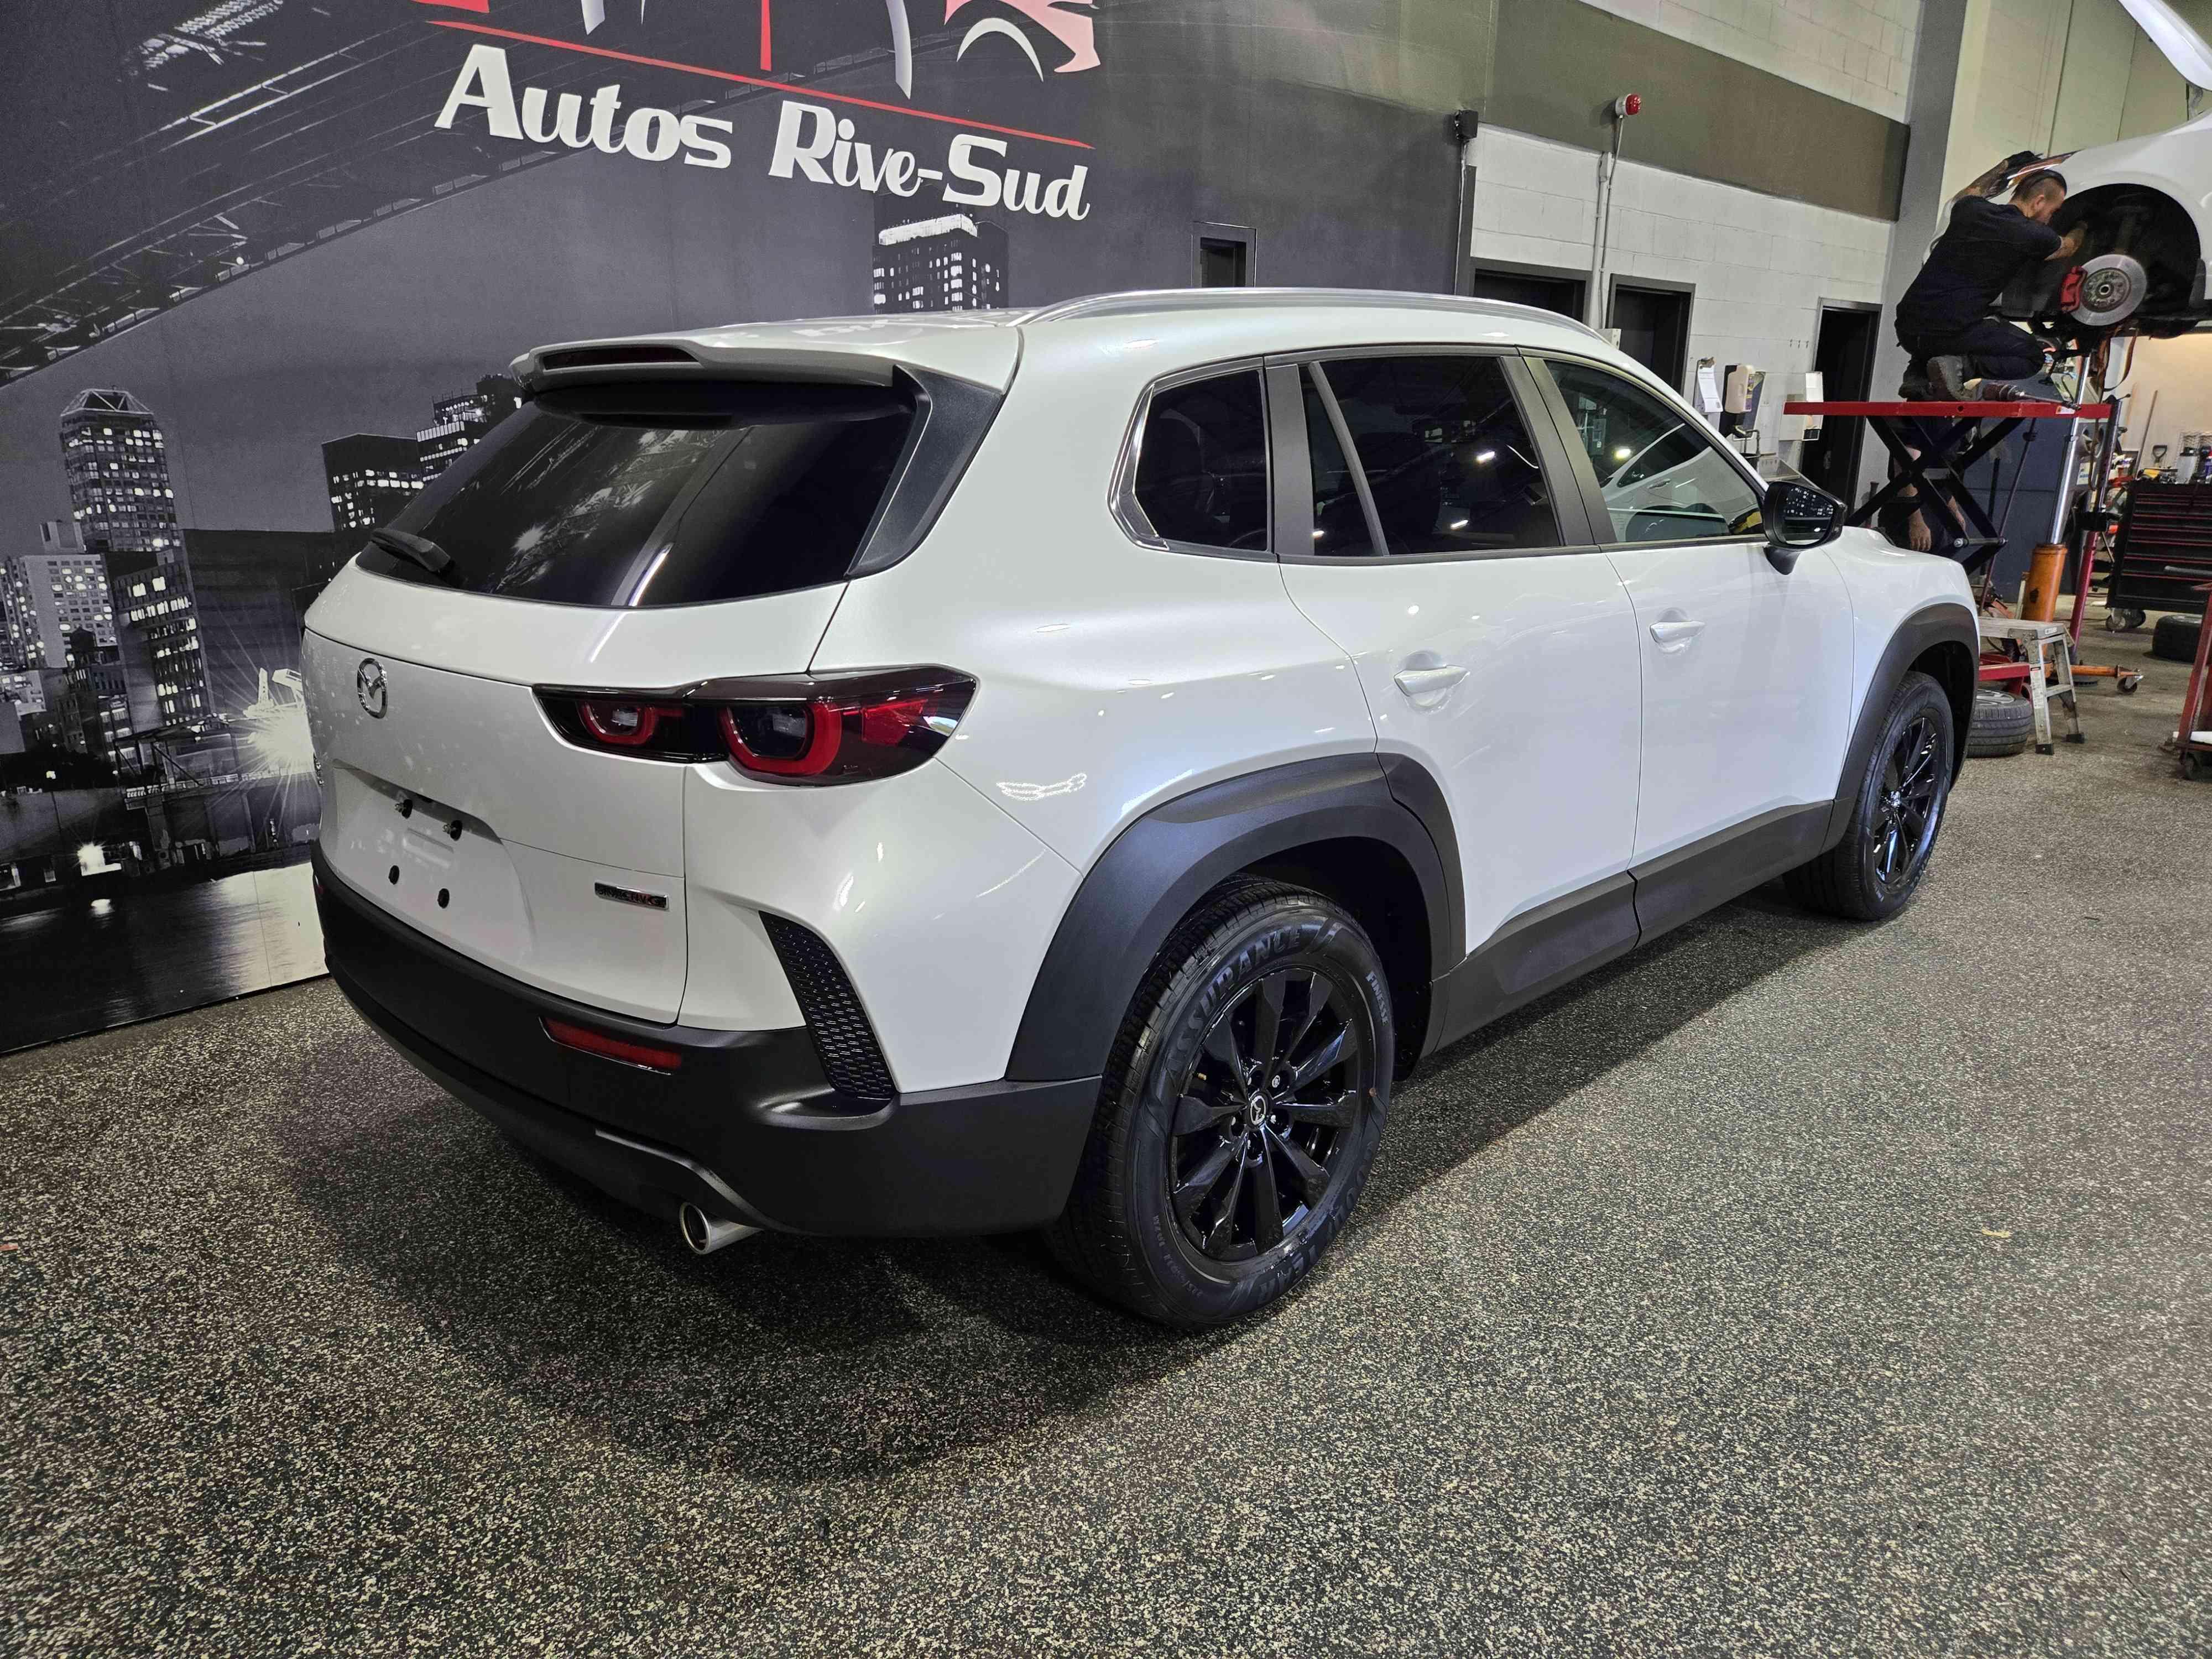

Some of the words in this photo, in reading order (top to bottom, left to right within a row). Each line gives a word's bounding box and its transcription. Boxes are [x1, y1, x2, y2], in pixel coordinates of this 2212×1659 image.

[434, 44, 733, 169] Autos
[769, 100, 1091, 221] Rive-Sud
[1365, 971, 1389, 1025] FINESSE
